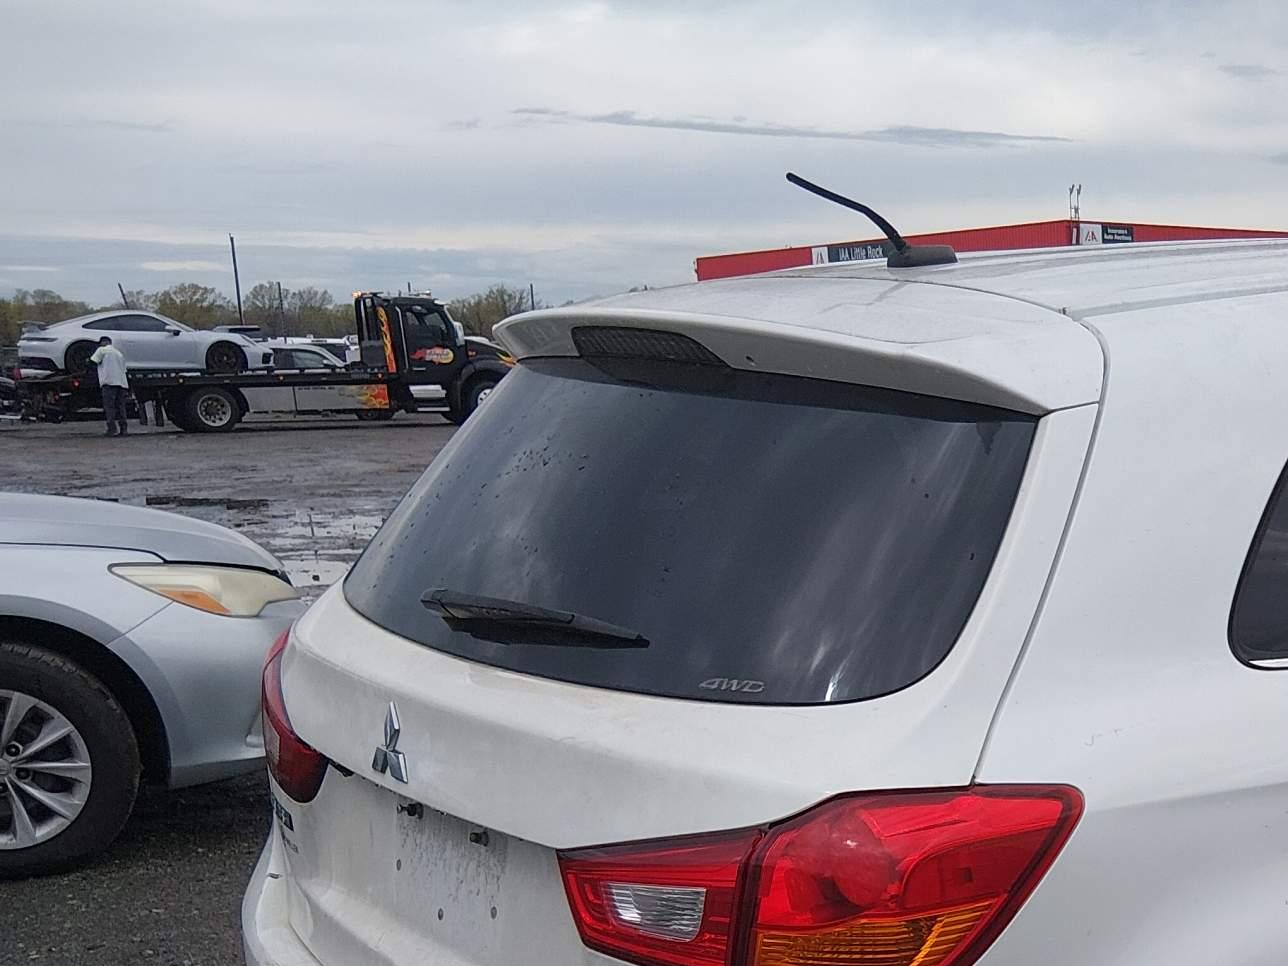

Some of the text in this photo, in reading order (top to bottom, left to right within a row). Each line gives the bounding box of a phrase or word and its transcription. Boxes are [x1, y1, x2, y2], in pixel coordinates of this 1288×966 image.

[850, 246, 866, 260] Little
[867, 244, 884, 259] Rock
[699, 678, 765, 693] 4WD
